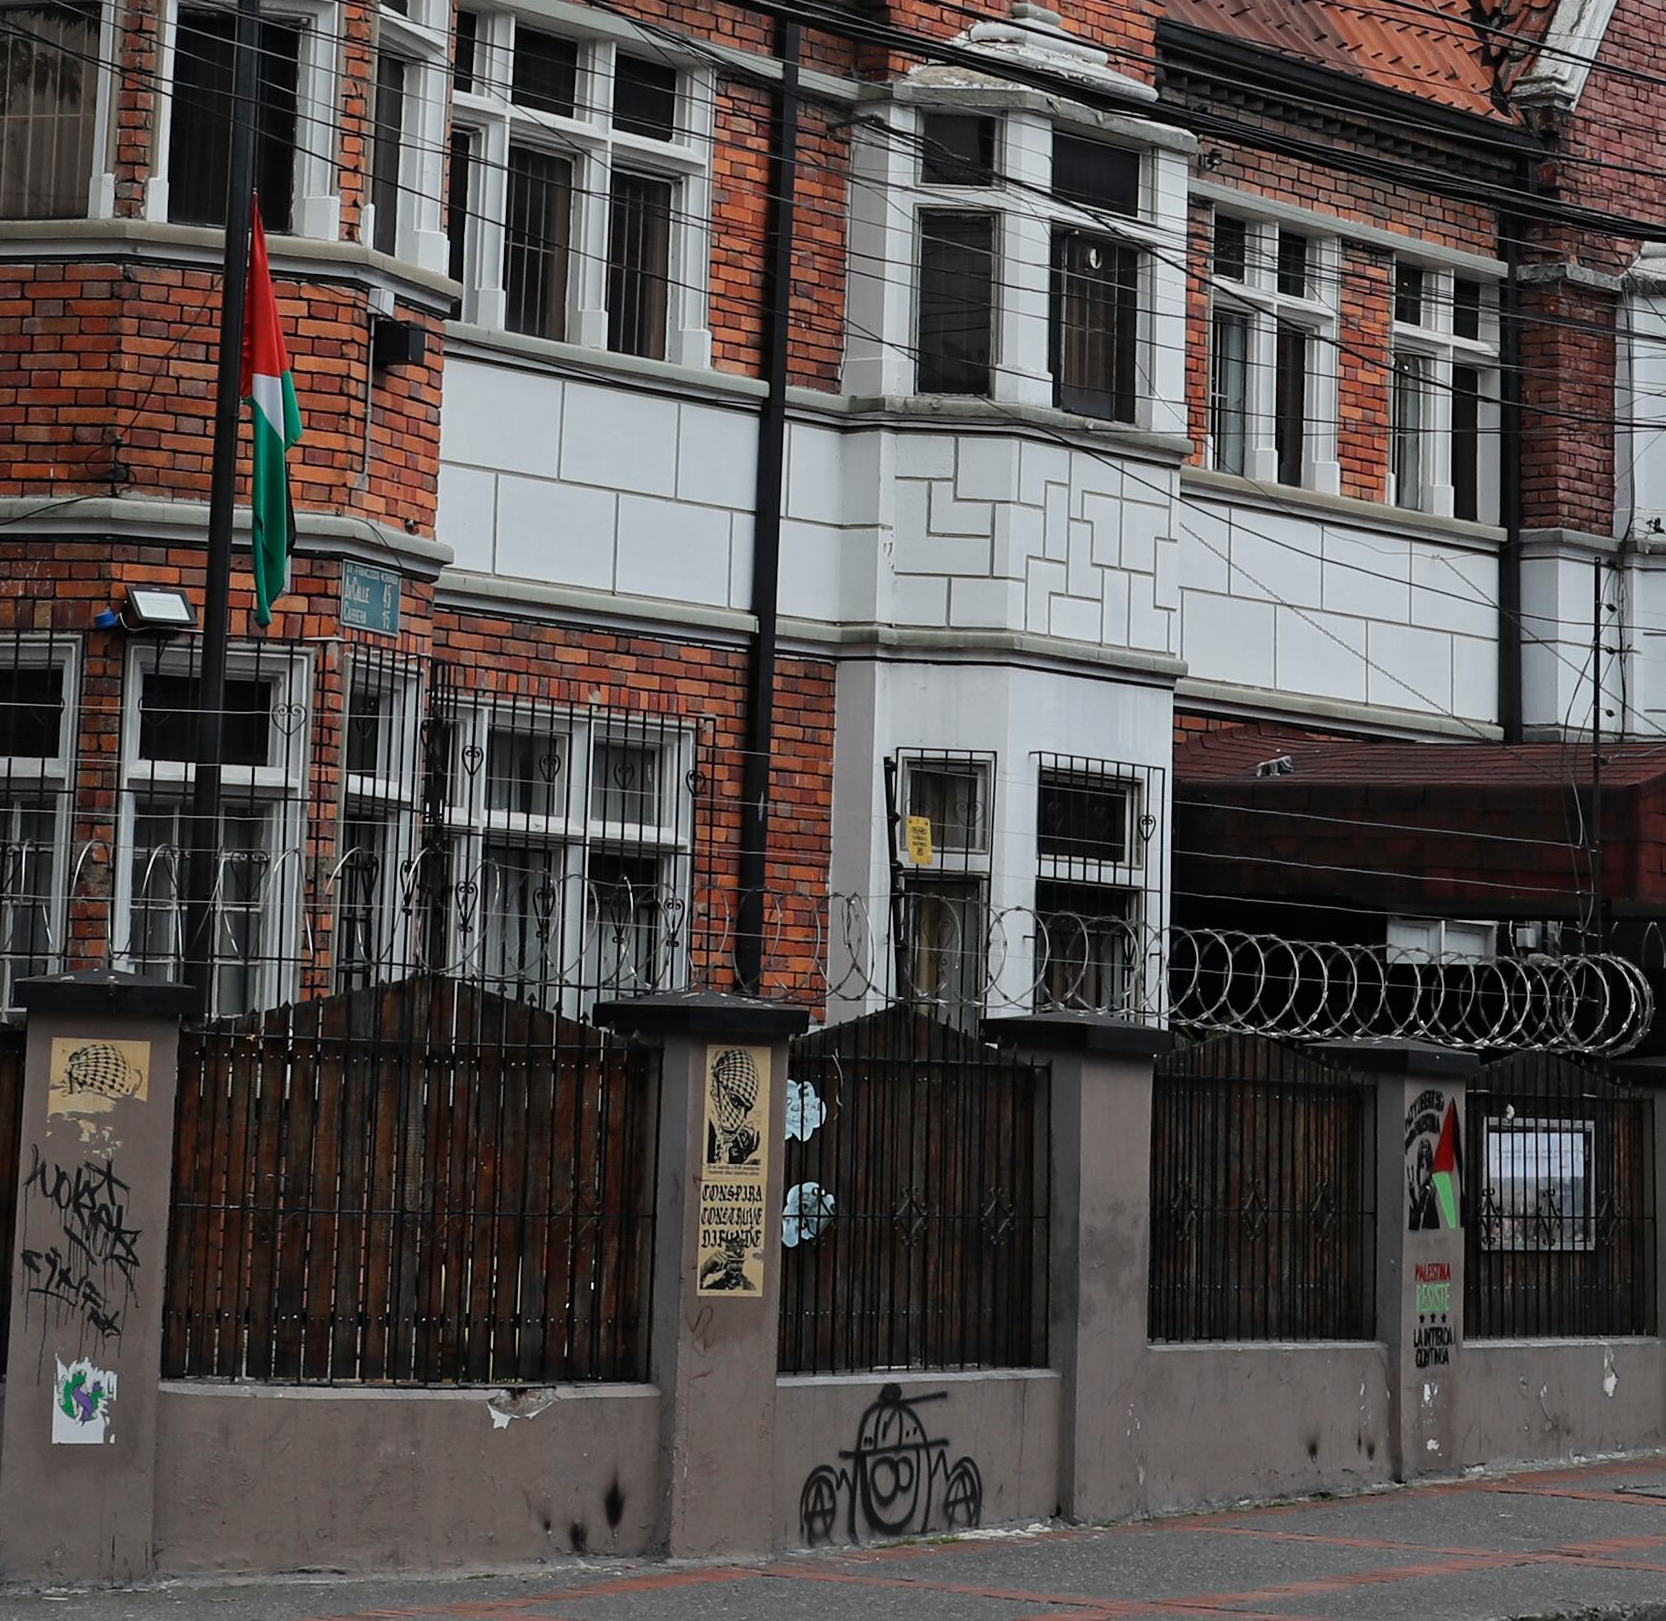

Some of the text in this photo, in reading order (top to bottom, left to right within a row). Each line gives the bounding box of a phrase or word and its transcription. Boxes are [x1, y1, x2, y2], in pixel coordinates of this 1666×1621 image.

[702, 1185, 763, 1204] CONSPIRA
[701, 1207, 763, 1229] CONSTRUYE
[701, 1229, 763, 1248] DIFUNDE
[1414, 1262, 1451, 1281] PALESTINA
[1416, 1283, 1450, 1312] RESISTE
